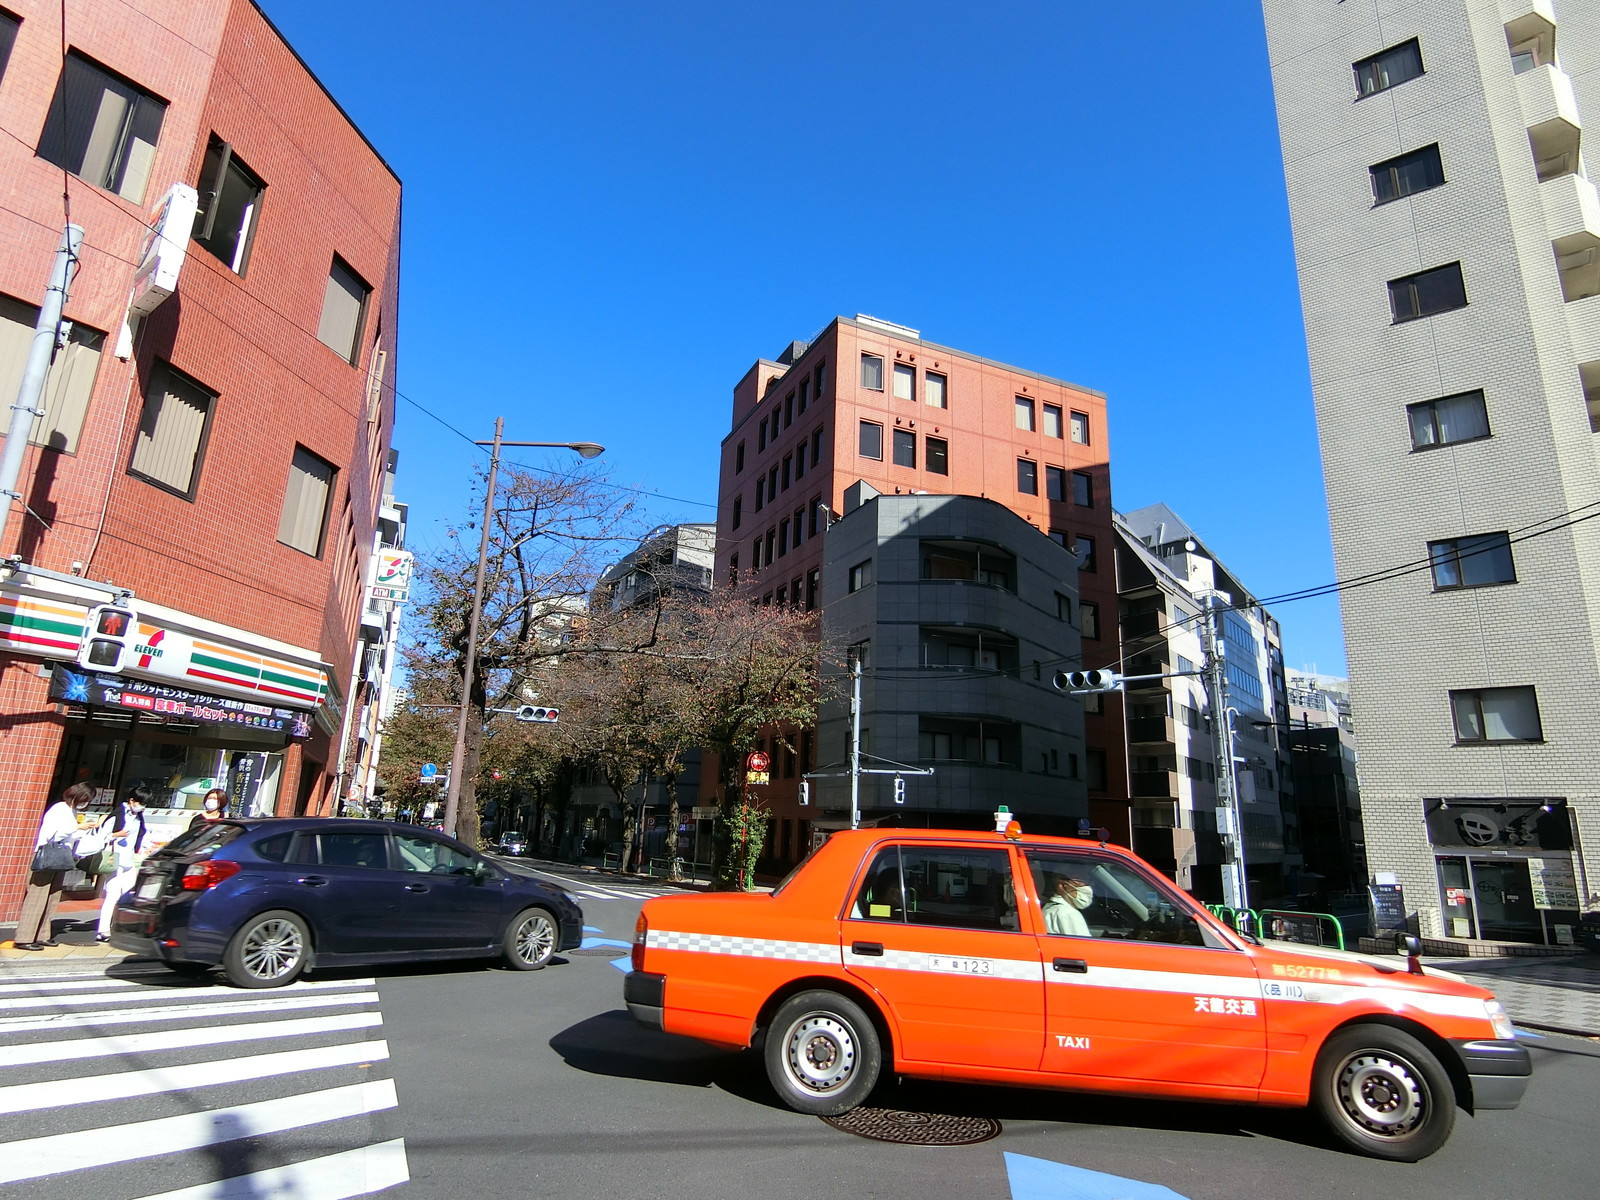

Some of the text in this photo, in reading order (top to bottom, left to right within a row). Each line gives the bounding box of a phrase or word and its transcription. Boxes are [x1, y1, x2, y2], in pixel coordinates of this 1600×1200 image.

[373, 588, 389, 598] ATM
[155, 698, 228, 721] 豪華ボールセット
[963, 961, 990, 973] 123
[1194, 997, 1257, 1016] 天龍交通
[1055, 1035, 1090, 1049] TAXI
